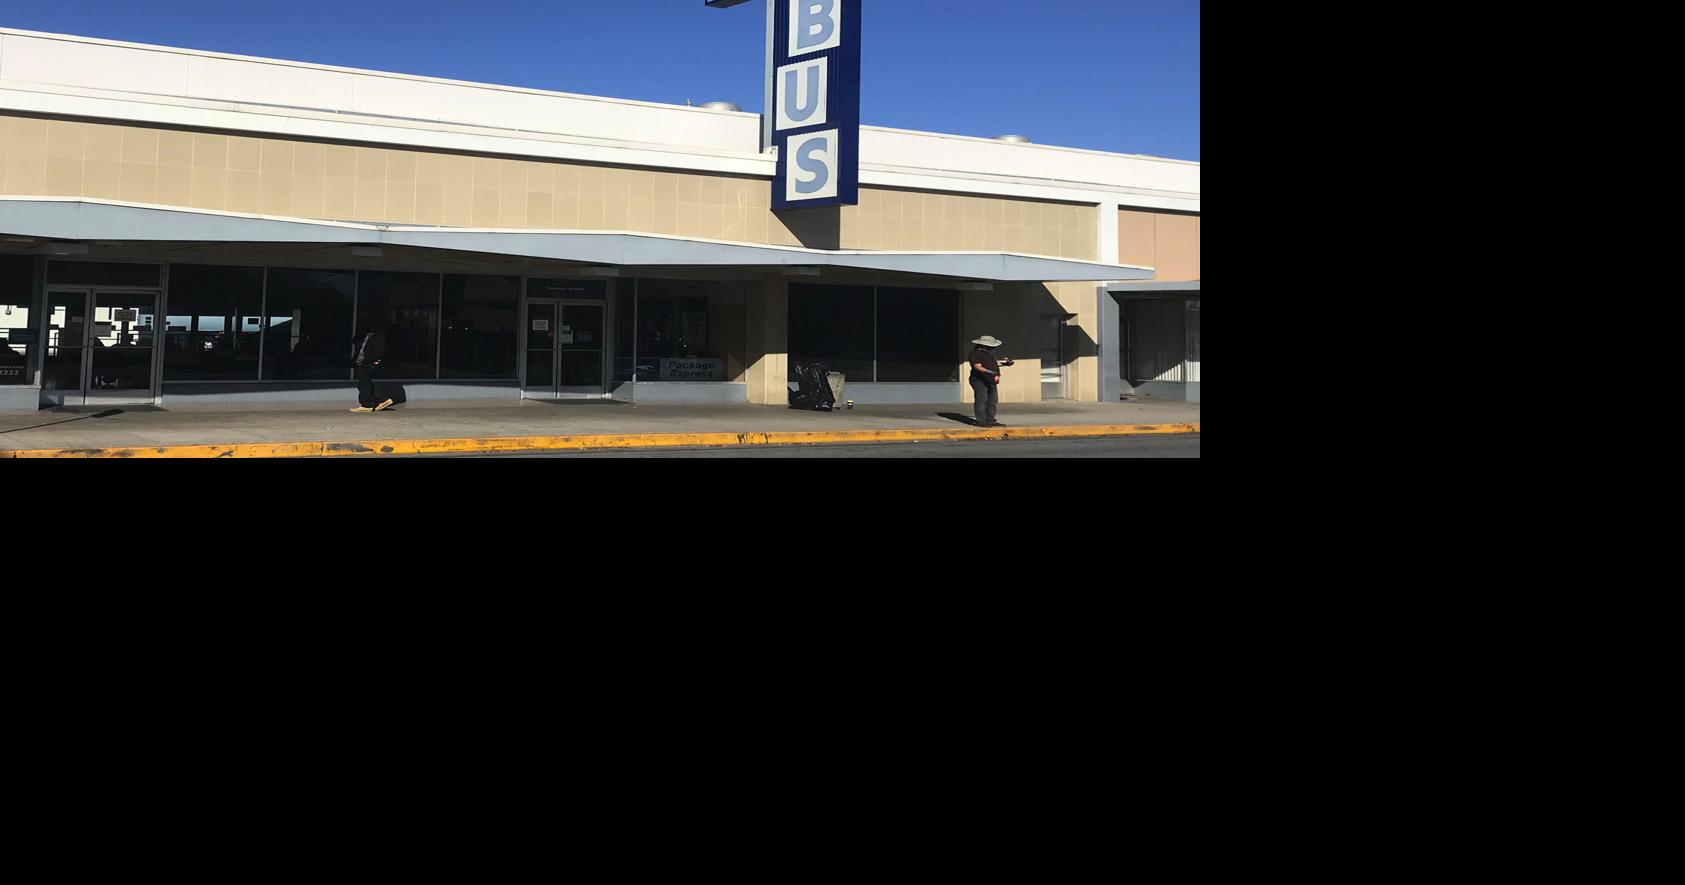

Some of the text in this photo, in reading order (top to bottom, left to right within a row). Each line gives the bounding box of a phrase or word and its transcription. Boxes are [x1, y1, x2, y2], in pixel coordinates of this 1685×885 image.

[784, 0, 835, 193] BUS
[668, 361, 715, 370] Package
[670, 369, 713, 378] Express
